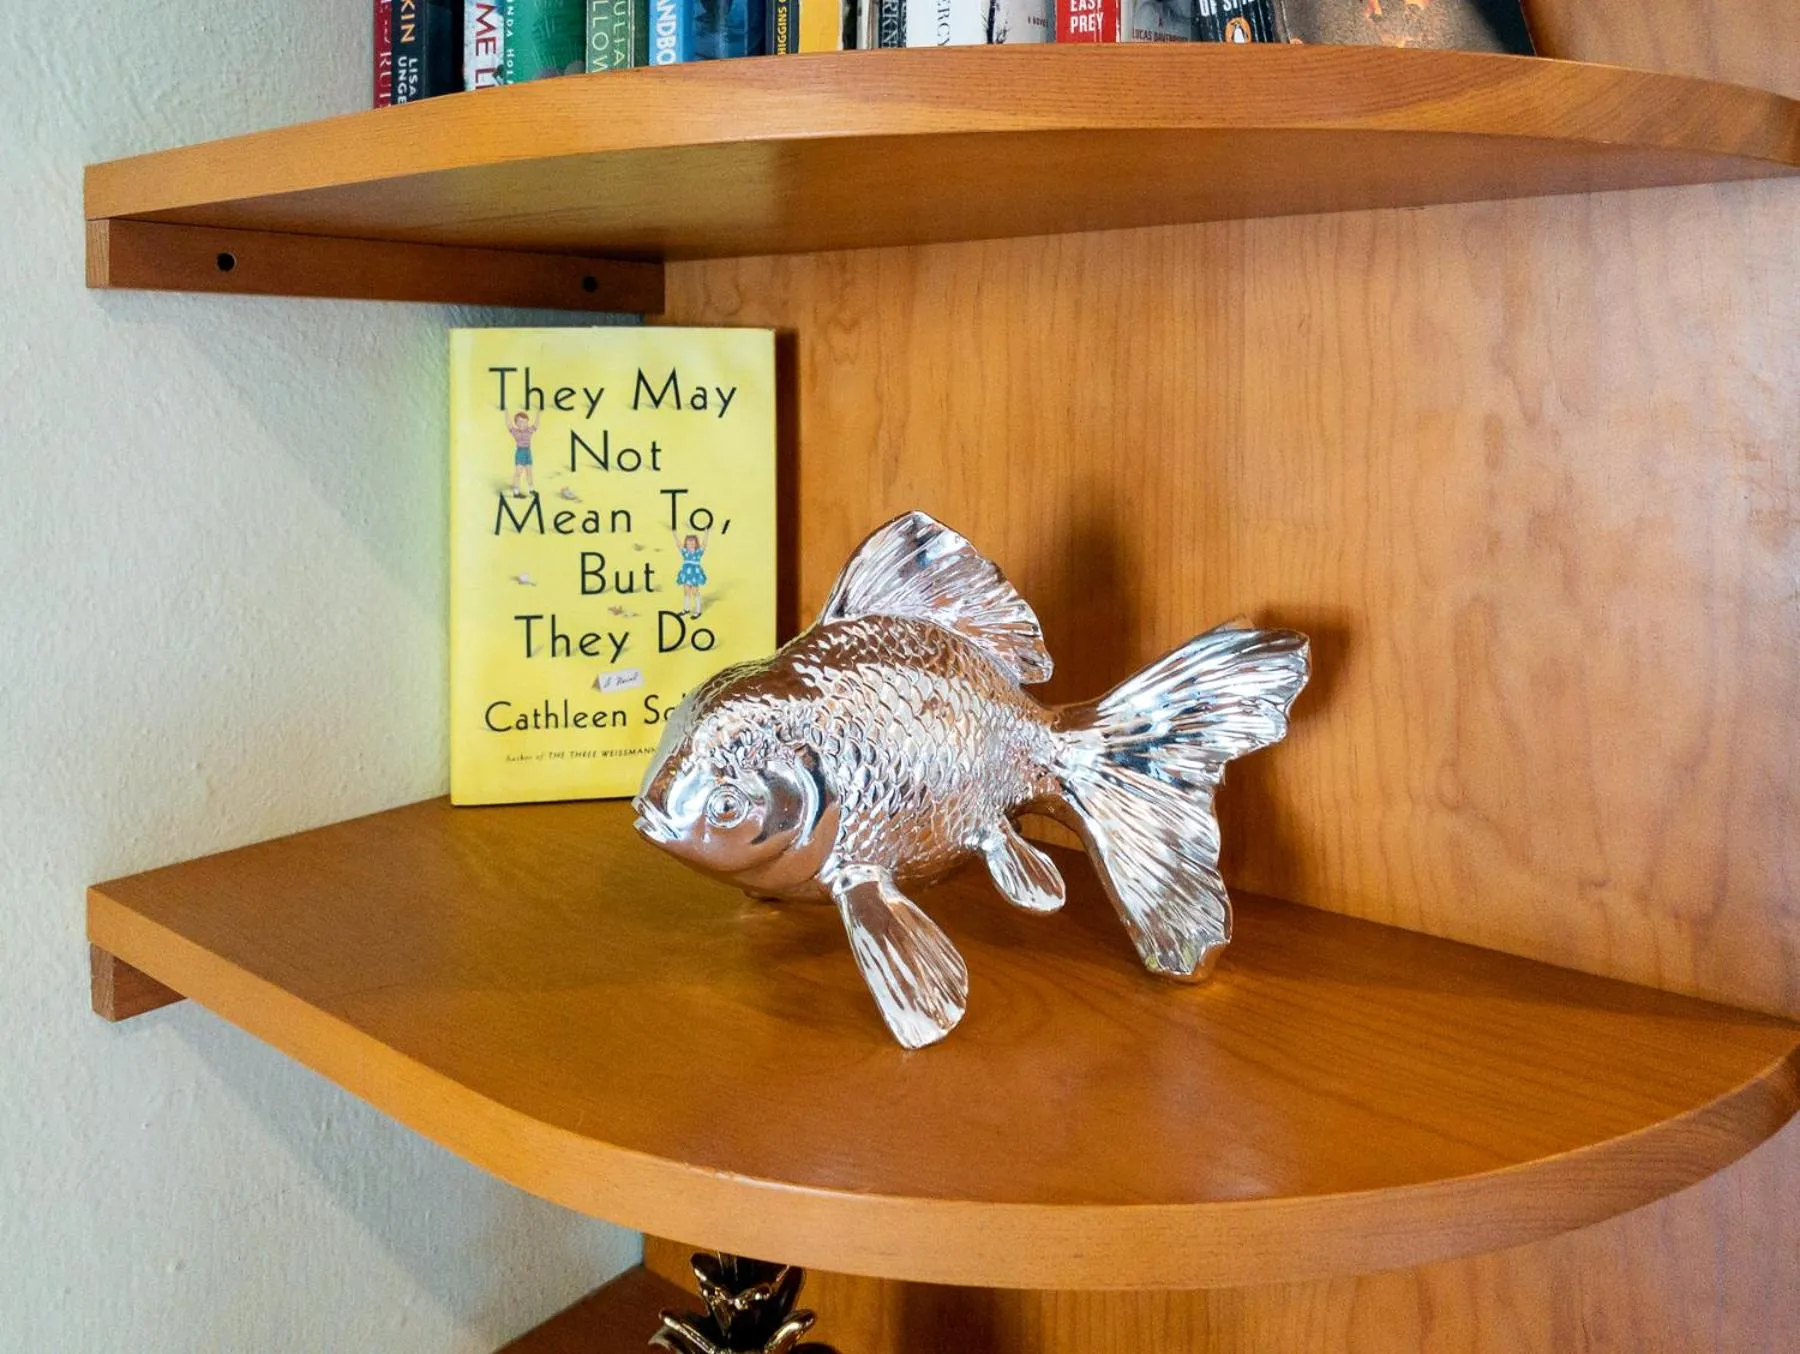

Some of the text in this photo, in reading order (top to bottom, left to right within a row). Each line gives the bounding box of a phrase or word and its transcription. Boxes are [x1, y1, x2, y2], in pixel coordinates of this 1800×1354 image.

[475, 2, 497, 56] ME
[776, 6, 787, 56] HIGGINS
[1070, 12, 1104, 34] PREY
[408, 57, 419, 97] LISA
[488, 366, 738, 419] They May
[569, 429, 663, 473] Not
[493, 488, 731, 536] Mean To,
[580, 551, 657, 596] But
[513, 610, 716, 664] They Do
[484, 693, 687, 733] Cathleen Sc
[548, 751, 566, 760] THE
[569, 750, 598, 759] THREE
